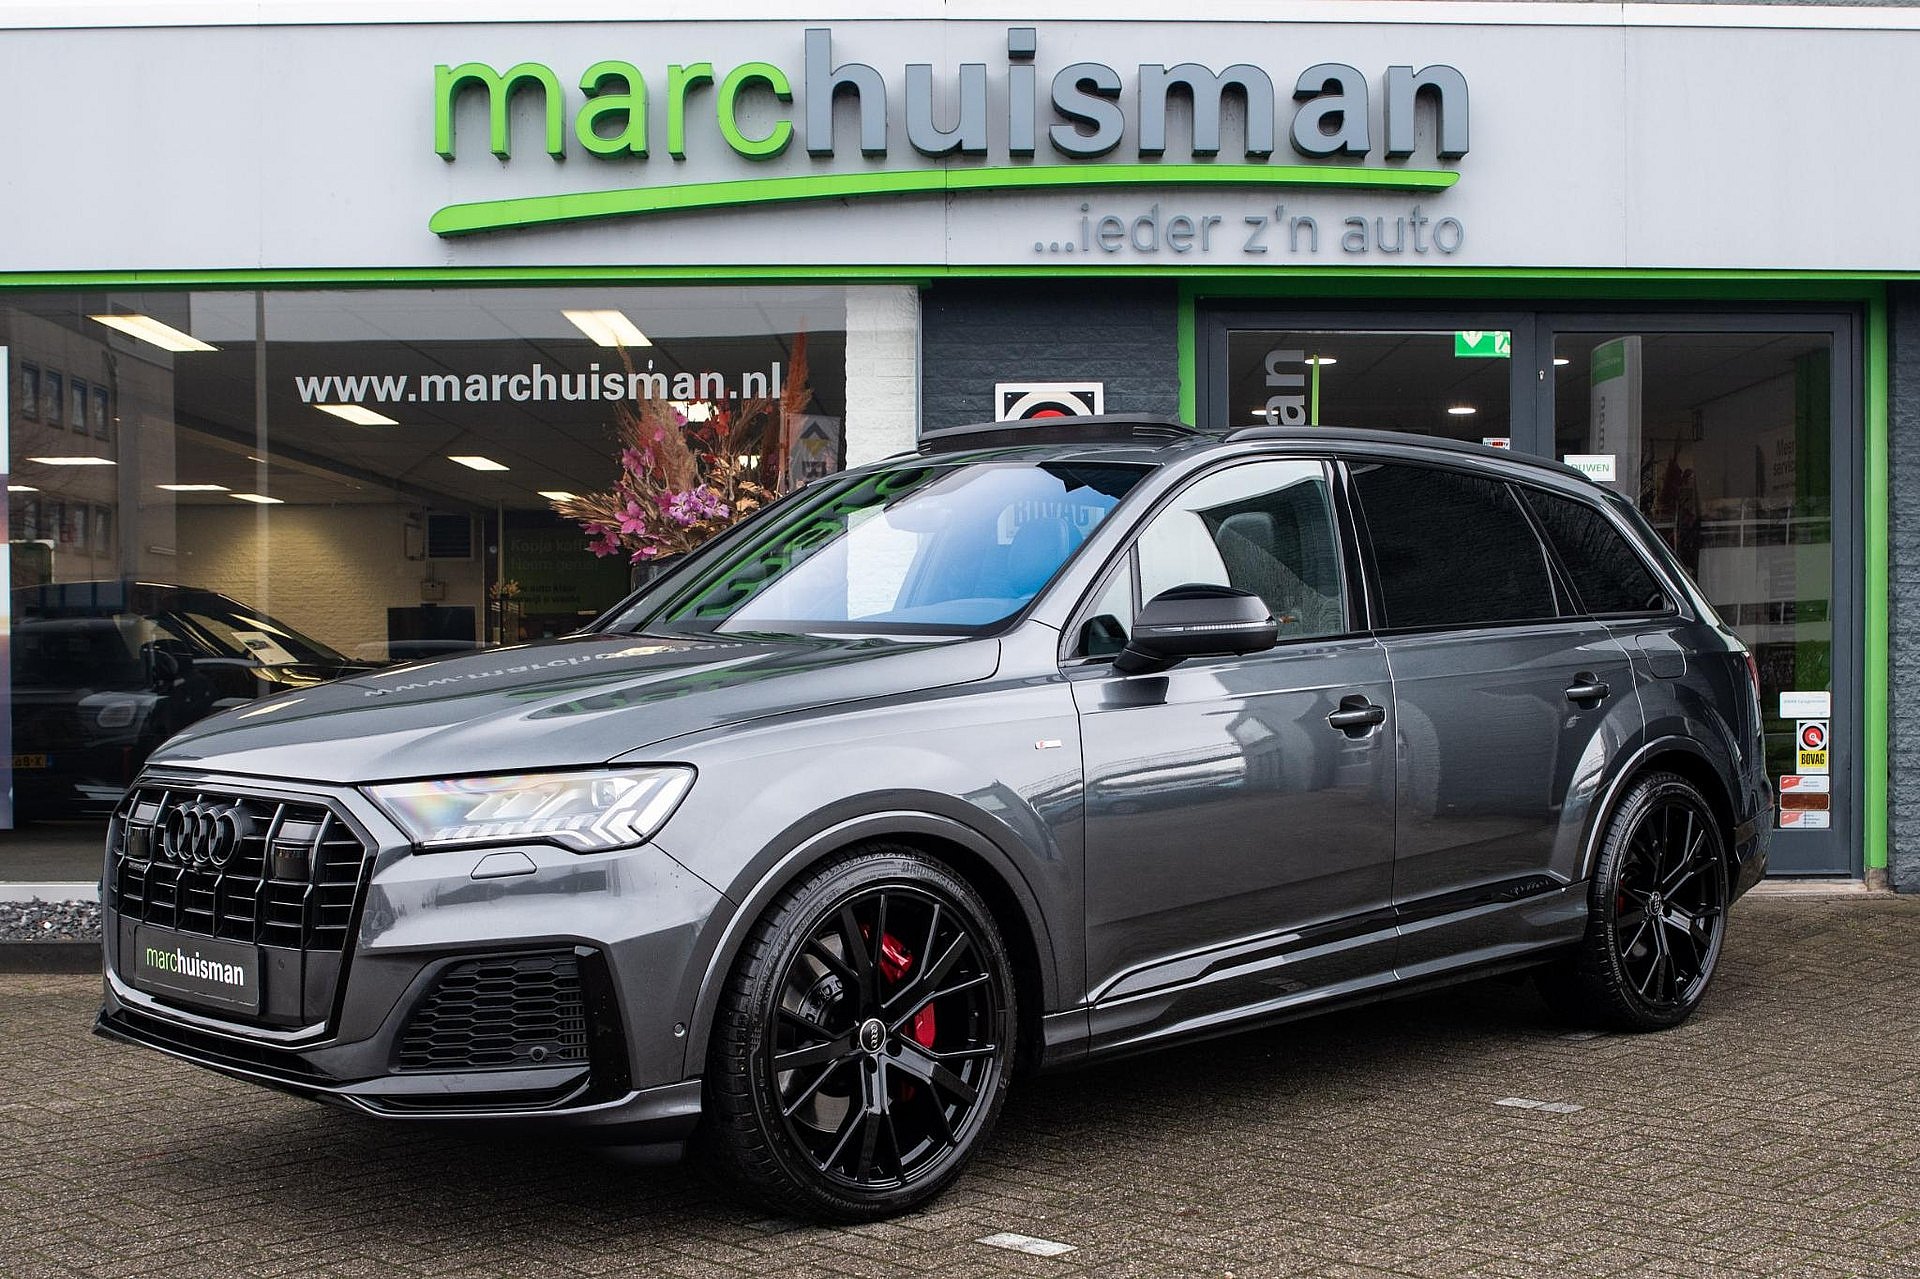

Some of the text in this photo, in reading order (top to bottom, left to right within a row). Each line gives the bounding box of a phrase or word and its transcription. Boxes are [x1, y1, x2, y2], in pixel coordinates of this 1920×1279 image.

[434, 28, 1470, 161] marchuisman
[1243, 204, 1319, 254] z'n
[1341, 204, 1466, 255] auto
[294, 361, 782, 403] www.marchuisman.nl
[1801, 753, 1825, 765] BOVAG
[146, 947, 244, 987] marchuisman
